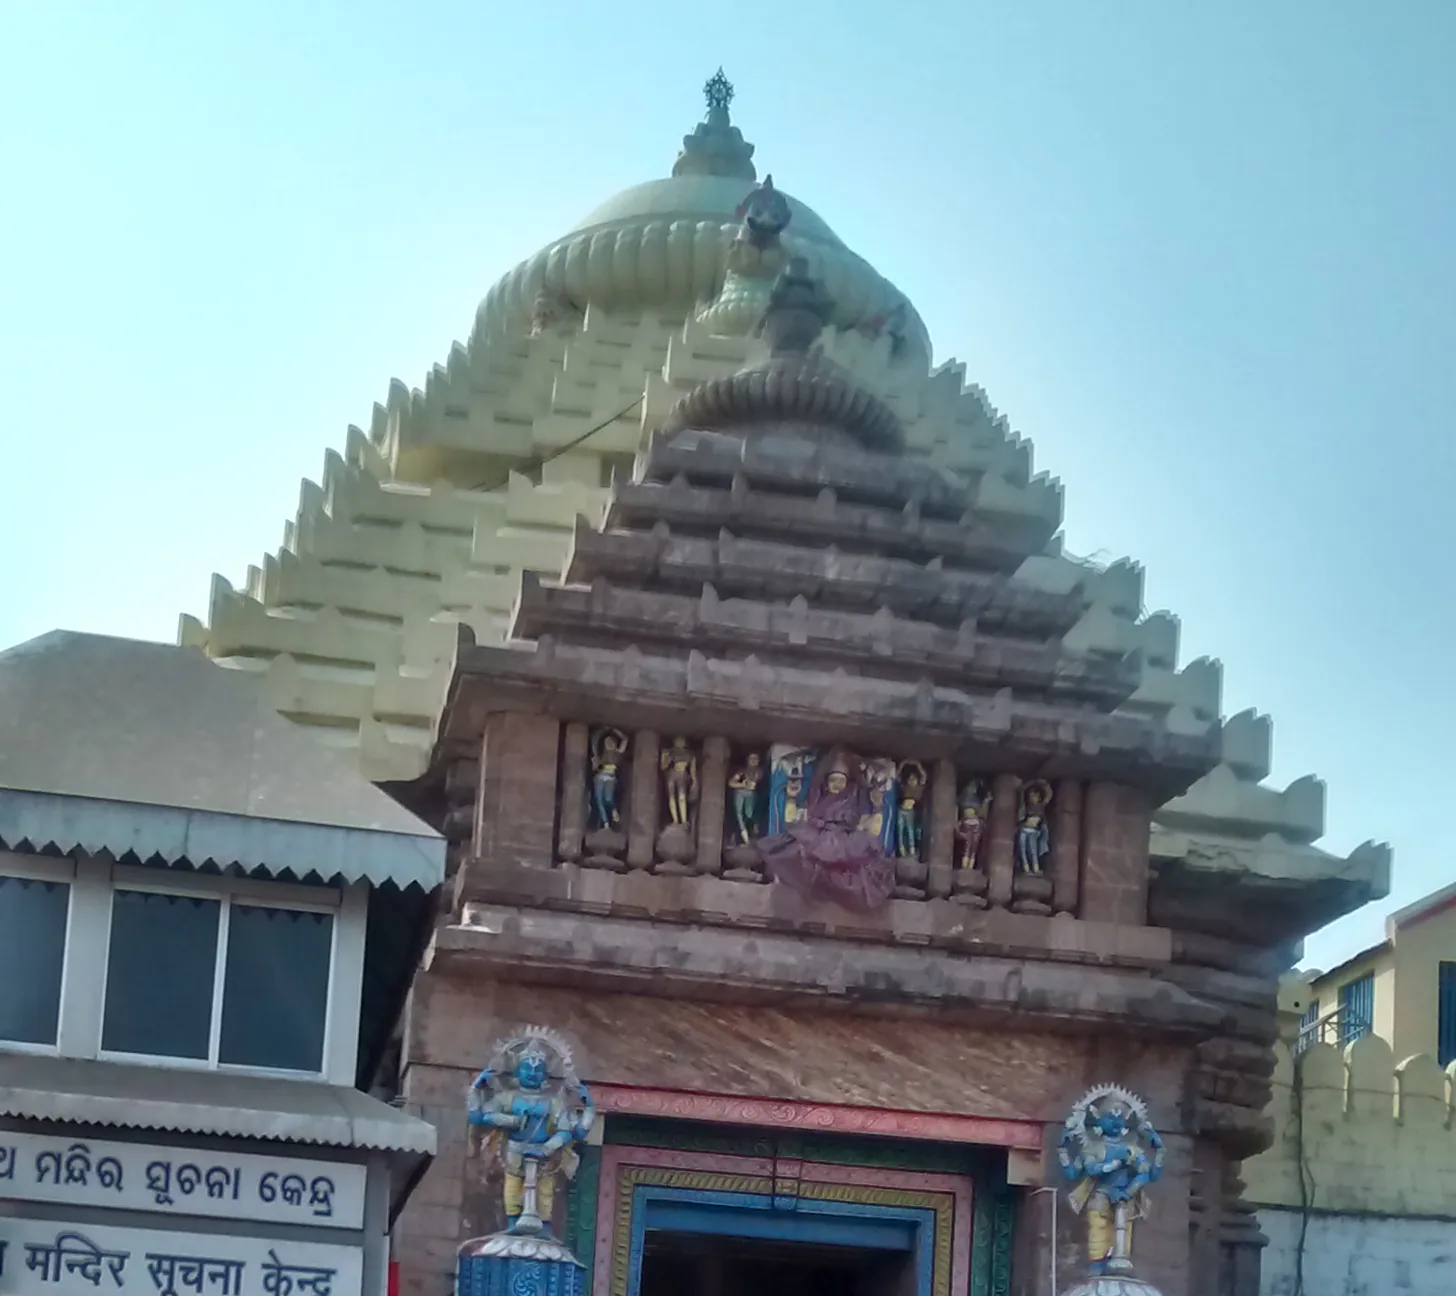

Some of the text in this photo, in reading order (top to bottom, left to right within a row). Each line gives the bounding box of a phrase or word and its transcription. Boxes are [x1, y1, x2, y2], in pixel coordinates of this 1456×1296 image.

[35, 1143, 123, 1192] ମନ୍ଦିର
[145, 1160, 241, 1206] ସୂଚନା
[258, 1171, 336, 1217] କେନ୍ଦ୍ର
[23, 1230, 131, 1289] मन्दिर
